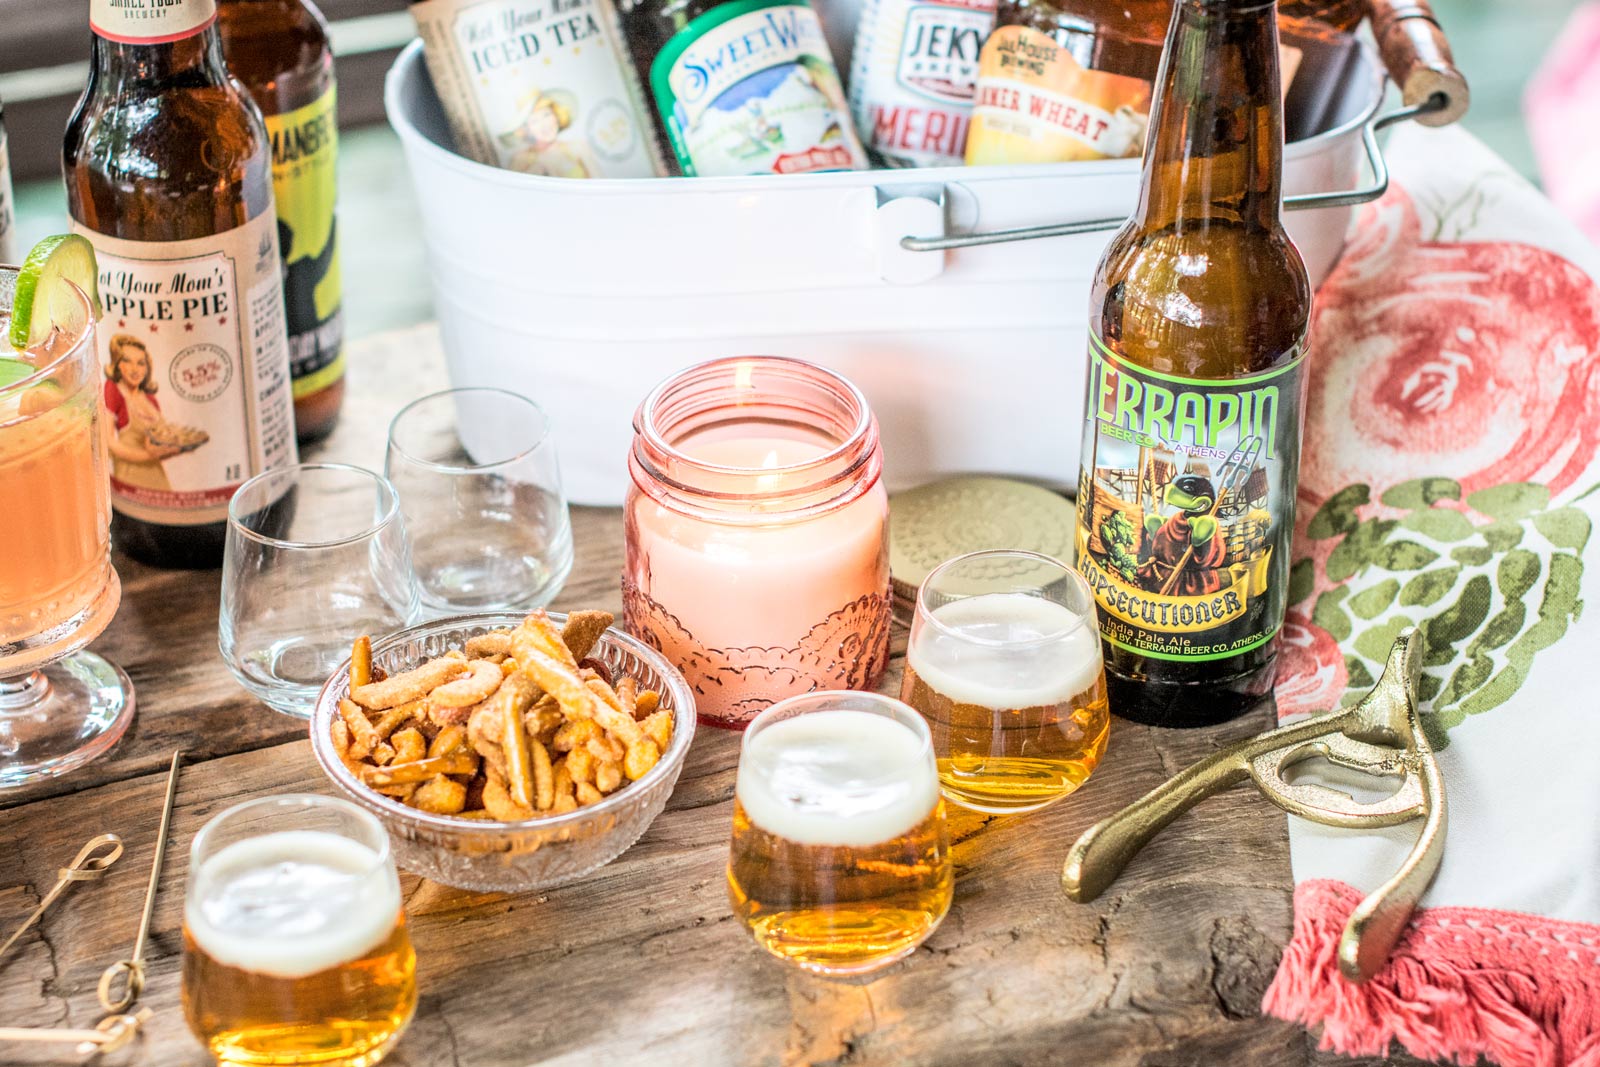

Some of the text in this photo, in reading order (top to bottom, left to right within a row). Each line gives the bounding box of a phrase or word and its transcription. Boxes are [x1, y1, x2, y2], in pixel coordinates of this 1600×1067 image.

[471, 12, 601, 74] ICED TEA
[1029, 94, 1109, 142] WHEAT
[99, 266, 226, 295] ot Your Mom's
[104, 292, 173, 321] PPLE
[182, 291, 229, 320] PIE
[1087, 341, 1280, 460] TERRAPIN
[1100, 422, 1133, 443] BEER
[1173, 443, 1227, 460] ATHENS
[1080, 554, 1242, 627] HOPSECUTIONER
[1106, 616, 1192, 647] India Pale Ale
[1133, 638, 1182, 656] TERRAPIN
[1183, 645, 1211, 656] BEER
